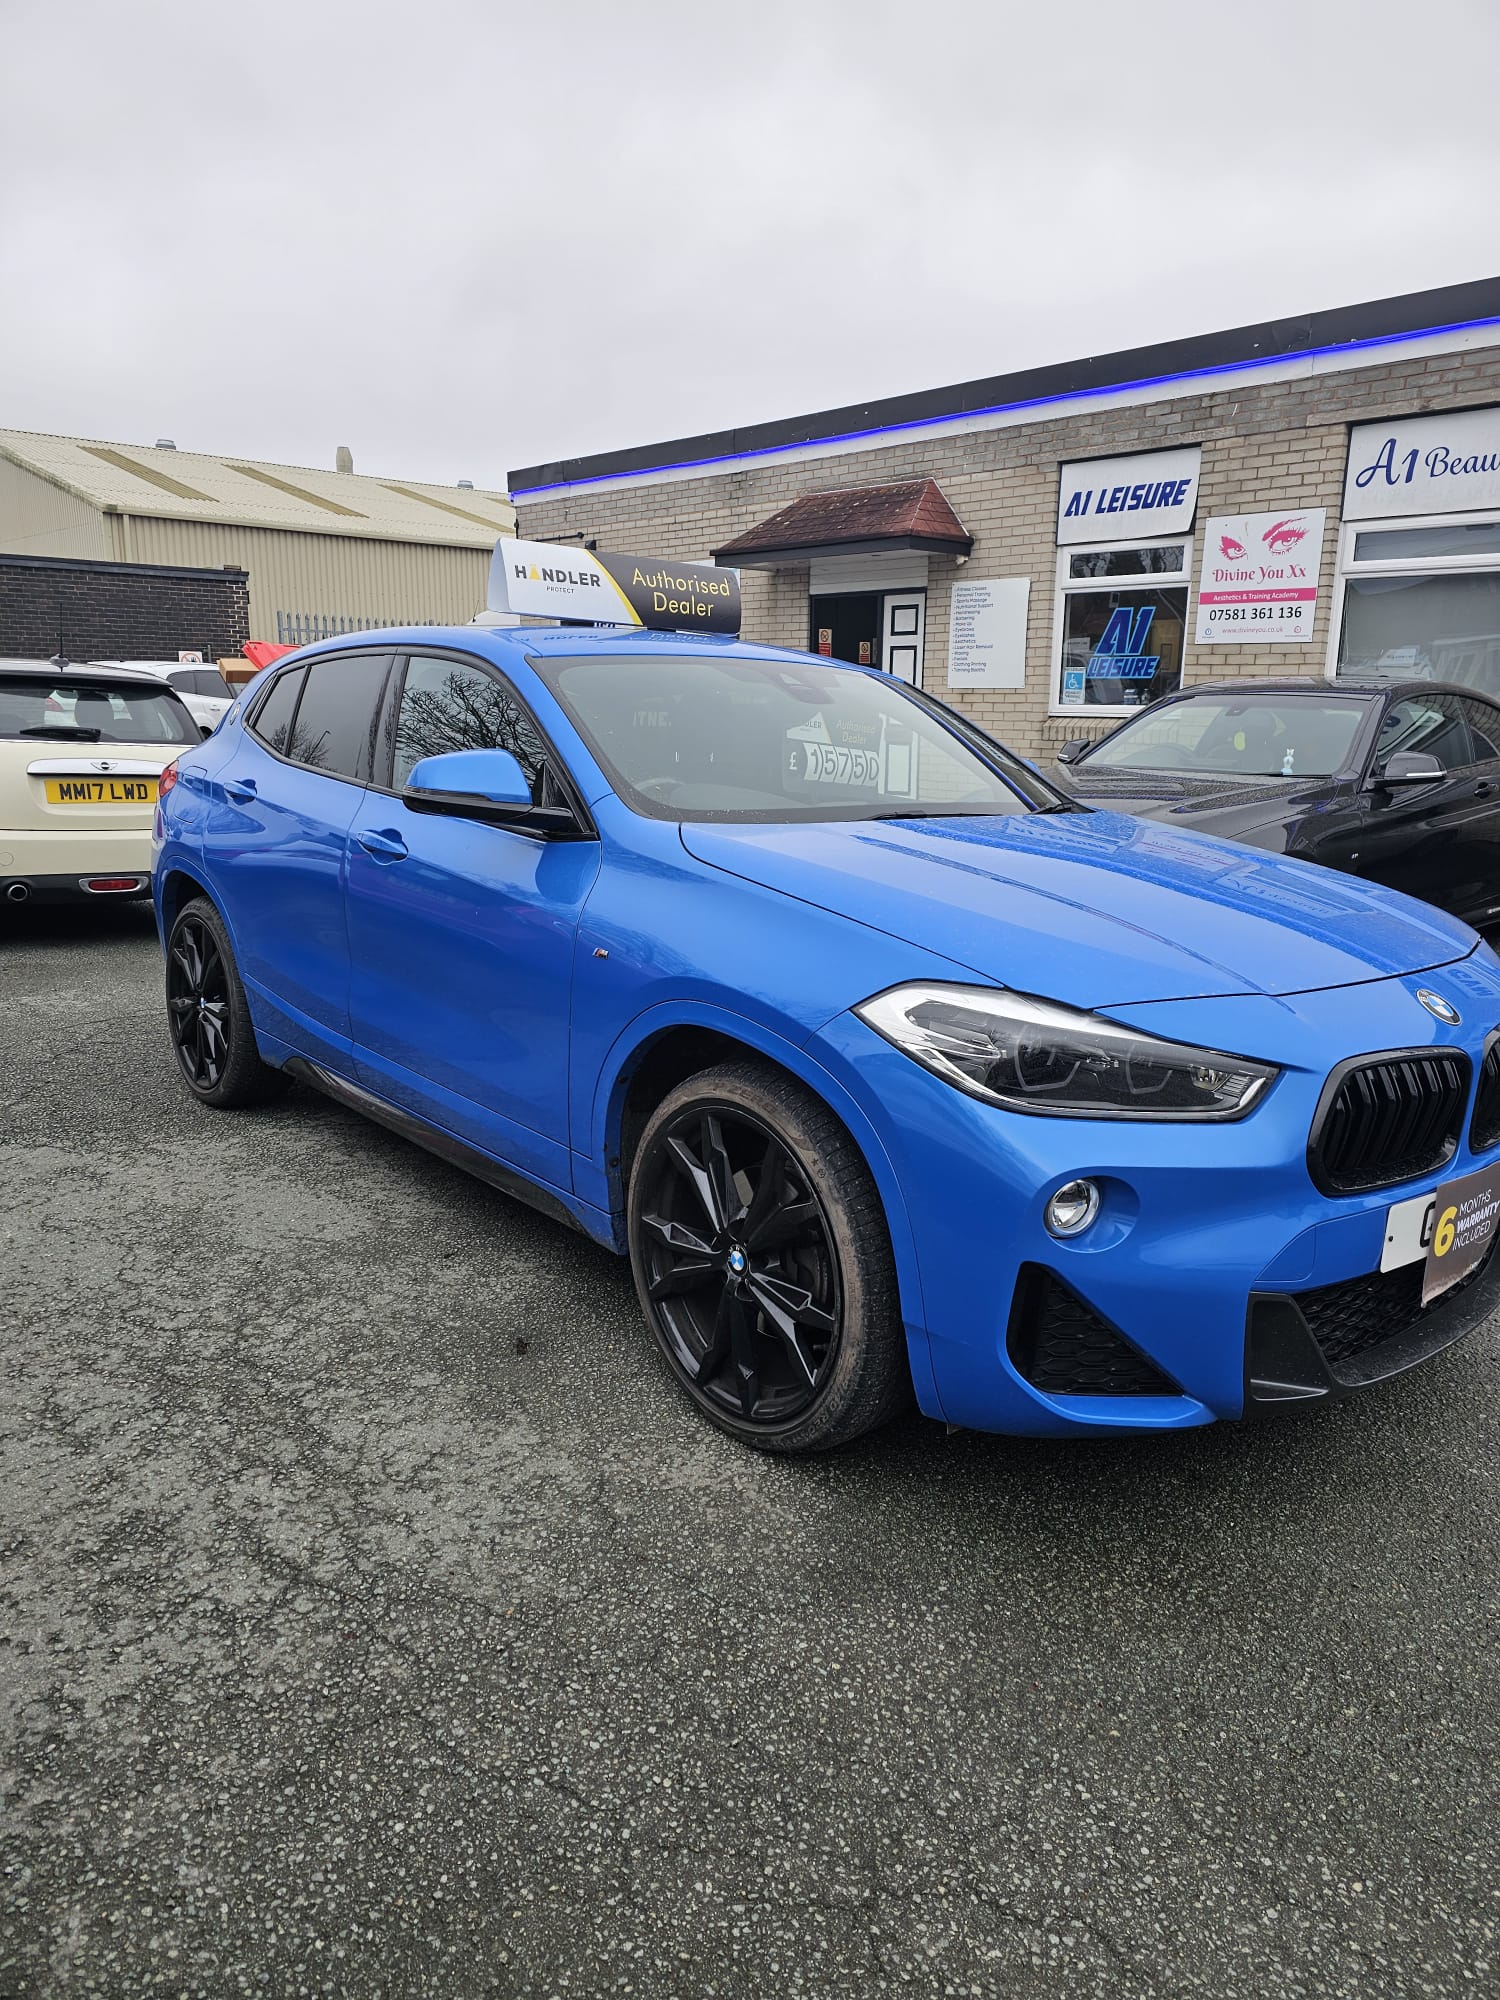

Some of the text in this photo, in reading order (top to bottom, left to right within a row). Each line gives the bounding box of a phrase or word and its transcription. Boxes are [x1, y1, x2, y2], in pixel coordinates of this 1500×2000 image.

[1355, 437, 1420, 488] A1
[1095, 478, 1192, 514] LEISURE
[514, 564, 601, 587] HANDLER
[632, 567, 730, 596] Authorised
[1212, 564, 1307, 585] Divine You Xx
[546, 586, 575, 594] PROTECT
[1213, 594, 1242, 602] Aesthetics
[1248, 592, 1271, 601] Training
[1271, 591, 1299, 600] Academy
[653, 592, 715, 617] Dealer
[1209, 606, 1302, 621] 07581 361 136
[1087, 657, 1160, 679] LEISURE
[789, 748, 879, 781] £ 15750
[59, 783, 149, 801] MM17 LWD
[1458, 1188, 1492, 1217] MONTHS
[1456, 1200, 1500, 1233] WARRANTY
[1434, 1206, 1458, 1257] 6
[1452, 1220, 1491, 1251] INCLUDED
